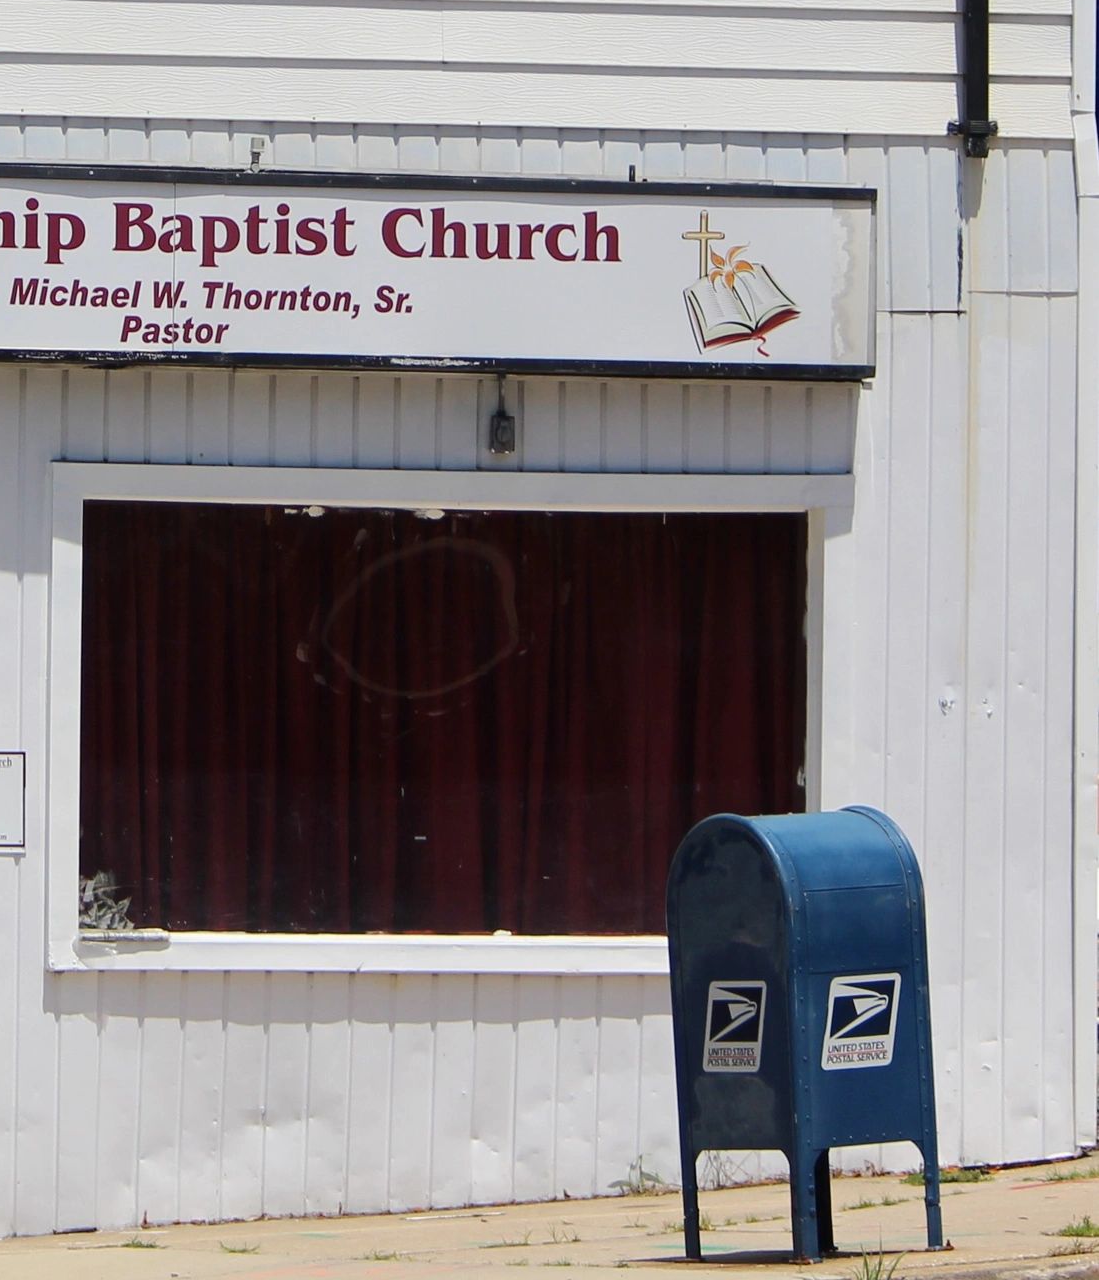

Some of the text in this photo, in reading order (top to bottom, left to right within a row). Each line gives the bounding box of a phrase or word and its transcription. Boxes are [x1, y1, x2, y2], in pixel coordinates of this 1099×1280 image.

[113, 202, 357, 268] Baptist
[381, 207, 622, 263] Church
[9, 278, 141, 308] Michael
[152, 281, 188, 309] W.
[202, 281, 361, 319] Thornton,
[374, 285, 414, 314] Sr.
[120, 315, 230, 345] Pastor
[708, 1047, 755, 1056] UNITED STATES
[827, 1041, 885, 1053] UNITED STATES
[707, 1058, 757, 1067] POSTAL SERVICE
[826, 1050, 888, 1064] POSTAL SERVICE
